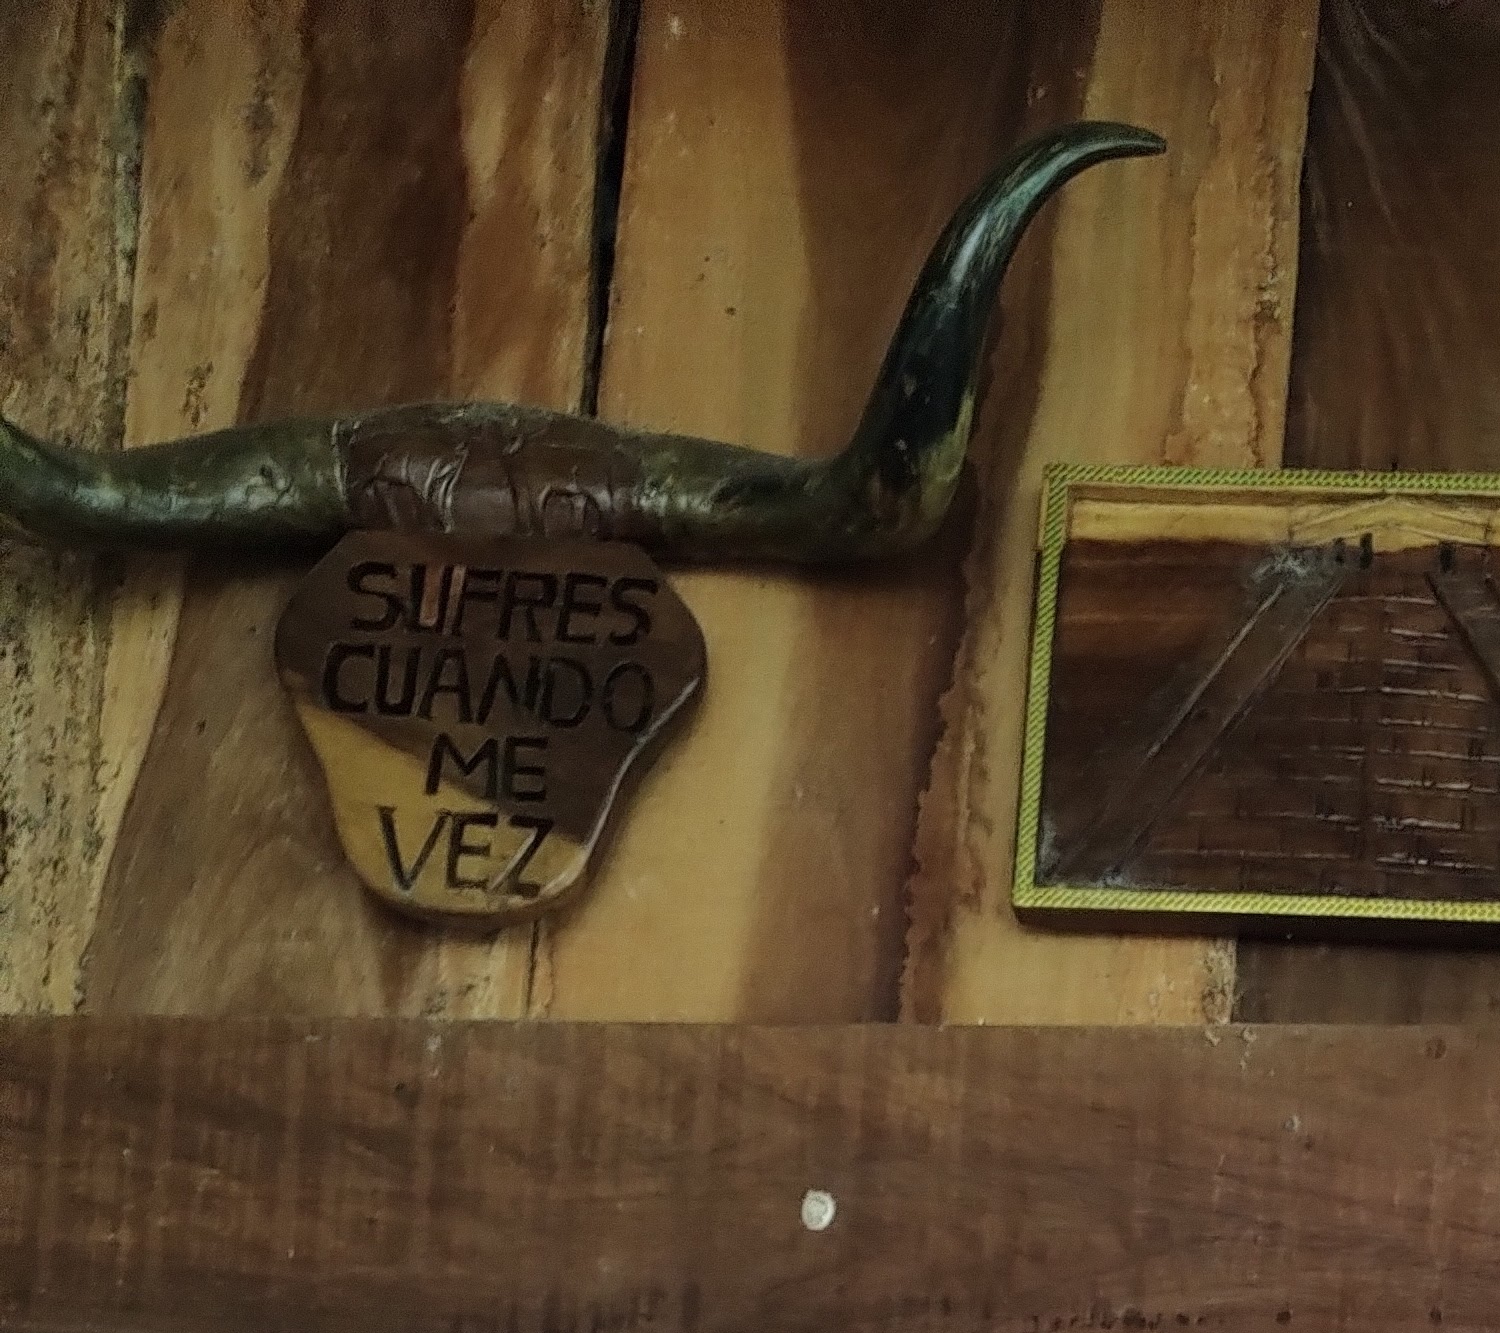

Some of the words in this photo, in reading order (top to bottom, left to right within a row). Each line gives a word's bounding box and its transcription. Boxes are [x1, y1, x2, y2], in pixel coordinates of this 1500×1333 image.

[347, 561, 660, 646] SUFRES
[322, 642, 656, 733] CUANDO
[424, 732, 550, 801] ME
[376, 805, 555, 898] VEZ
